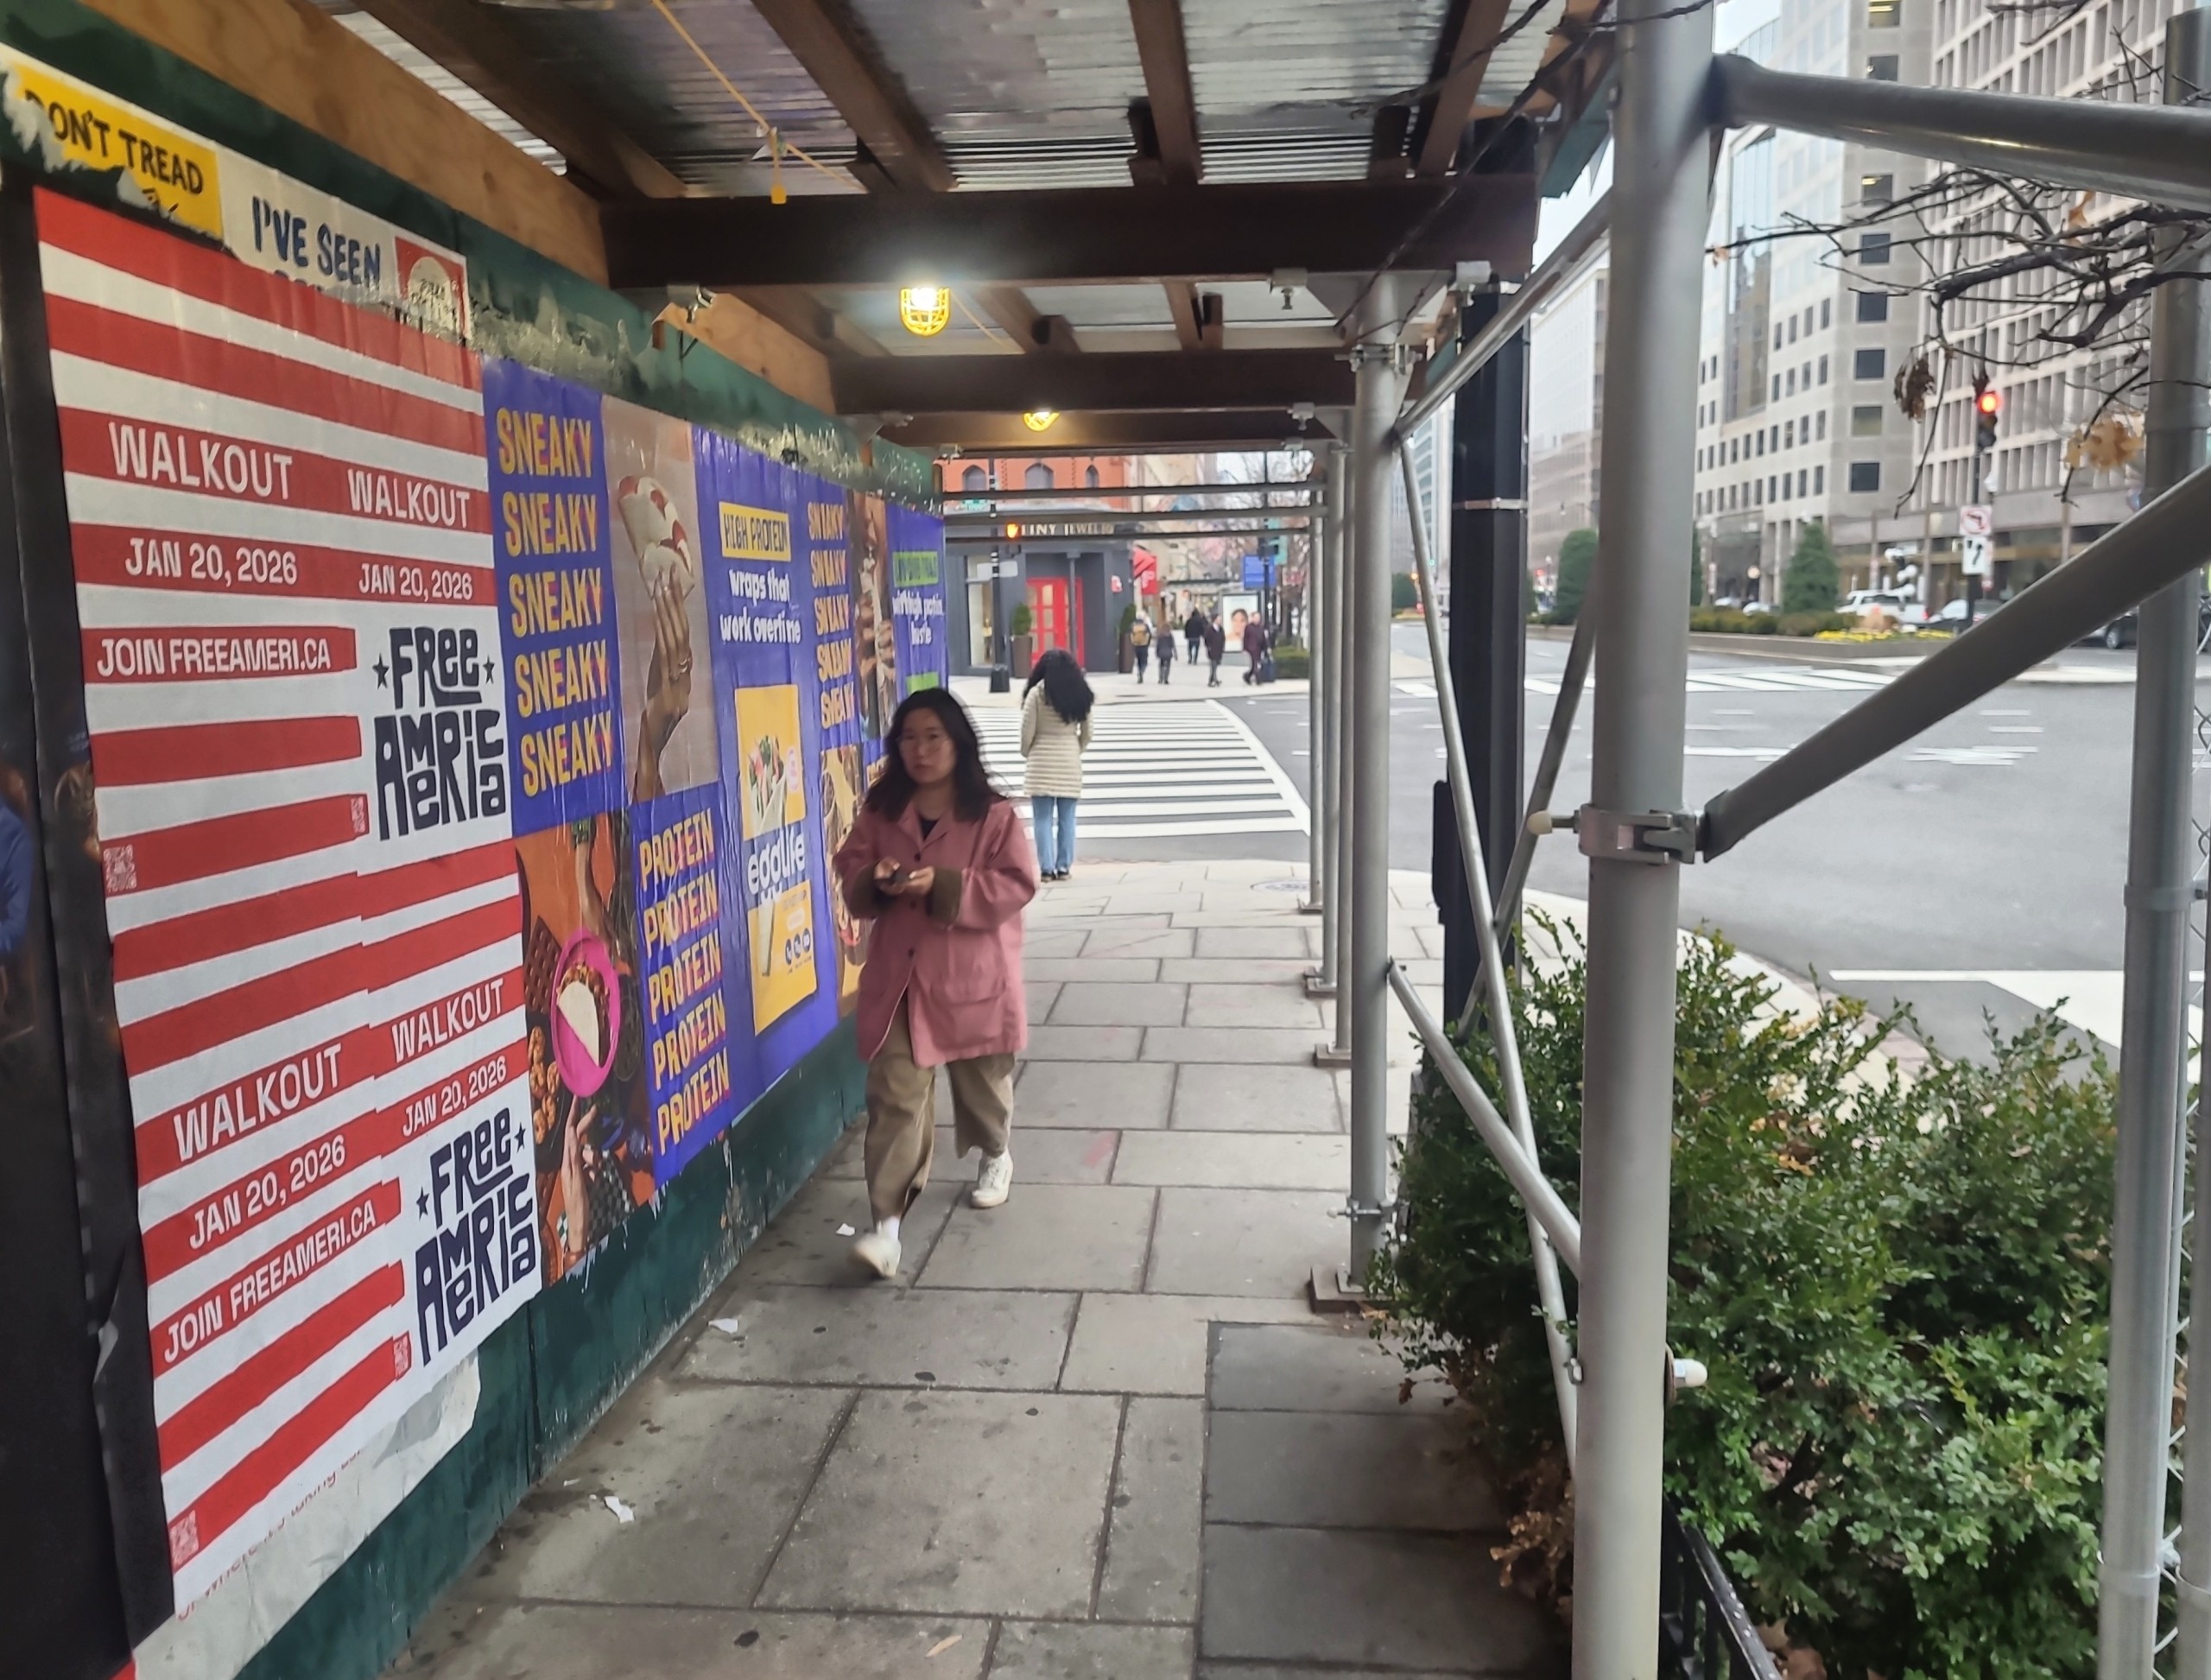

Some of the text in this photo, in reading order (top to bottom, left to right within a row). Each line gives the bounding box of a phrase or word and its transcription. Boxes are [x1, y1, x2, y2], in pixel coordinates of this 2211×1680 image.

[24, 89, 204, 196] ON'T TREAD
[252, 195, 308, 268] I'VE
[316, 222, 381, 290] SEEN
[109, 421, 293, 500] WALKOUT
[496, 407, 592, 478] SNEAKY
[347, 467, 471, 529] WALKOUT
[503, 491, 597, 557] SNEAKY
[723, 514, 788, 553] HIGH PROTEIN
[125, 537, 182, 578] JAN
[358, 562, 396, 595] JAN
[729, 567, 790, 607] wraps that
[509, 567, 602, 638] SNEAKY
[719, 606, 753, 644] work
[97, 637, 332, 677] JOIN FREEAMERI.CA
[515, 639, 607, 719] SNEAKY
[521, 710, 613, 797] SNEAKY
[639, 807, 715, 892] PROTEIN
[643, 869, 718, 960] PROTEIN
[649, 928, 722, 1025] PROTEIN
[391, 978, 505, 1063] WALKOUT
[653, 987, 726, 1092] PROTEIN
[174, 1043, 342, 1162] WALKOUT
[402, 1093, 437, 1137] JAN
[657, 1046, 730, 1157] PROTEIN
[189, 1190, 242, 1250] JAN
[164, 1199, 377, 1363] JOIN FREEAMERI.CA
